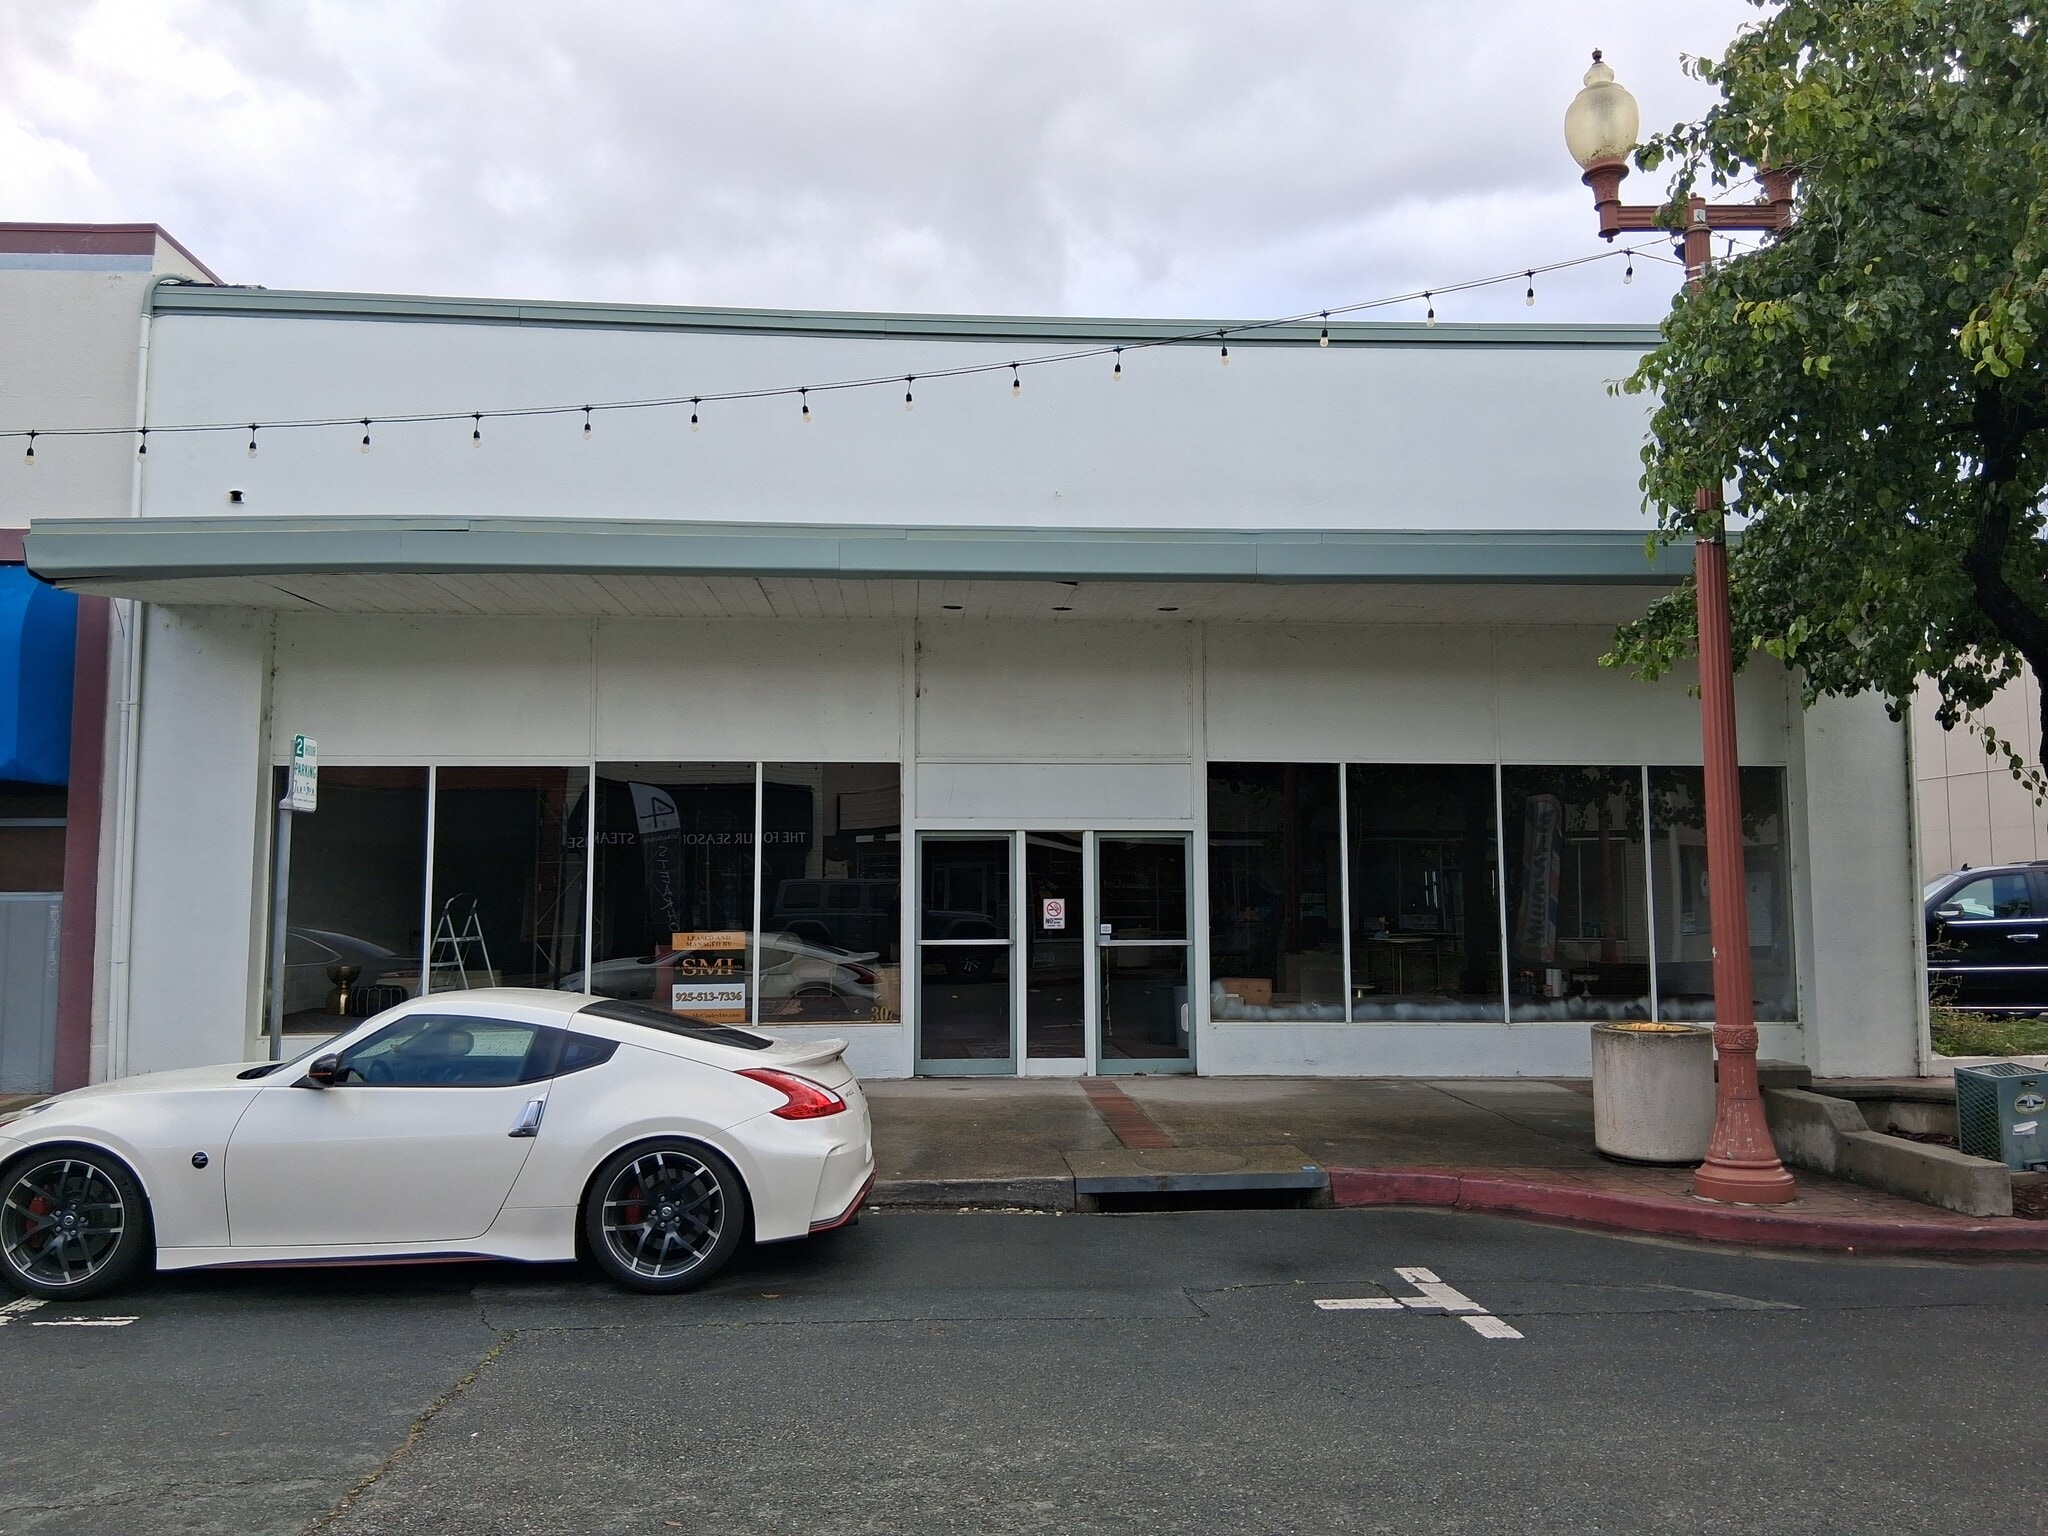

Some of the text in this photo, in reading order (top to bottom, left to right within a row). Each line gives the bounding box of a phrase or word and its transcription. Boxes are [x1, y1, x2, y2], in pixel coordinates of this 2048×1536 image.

[296, 738, 303, 754] 2
[294, 762, 316, 780] PARKING
[1045, 917, 1054, 925] NO
[682, 958, 735, 976] SMI
[675, 991, 743, 1002] 925-513-7336
